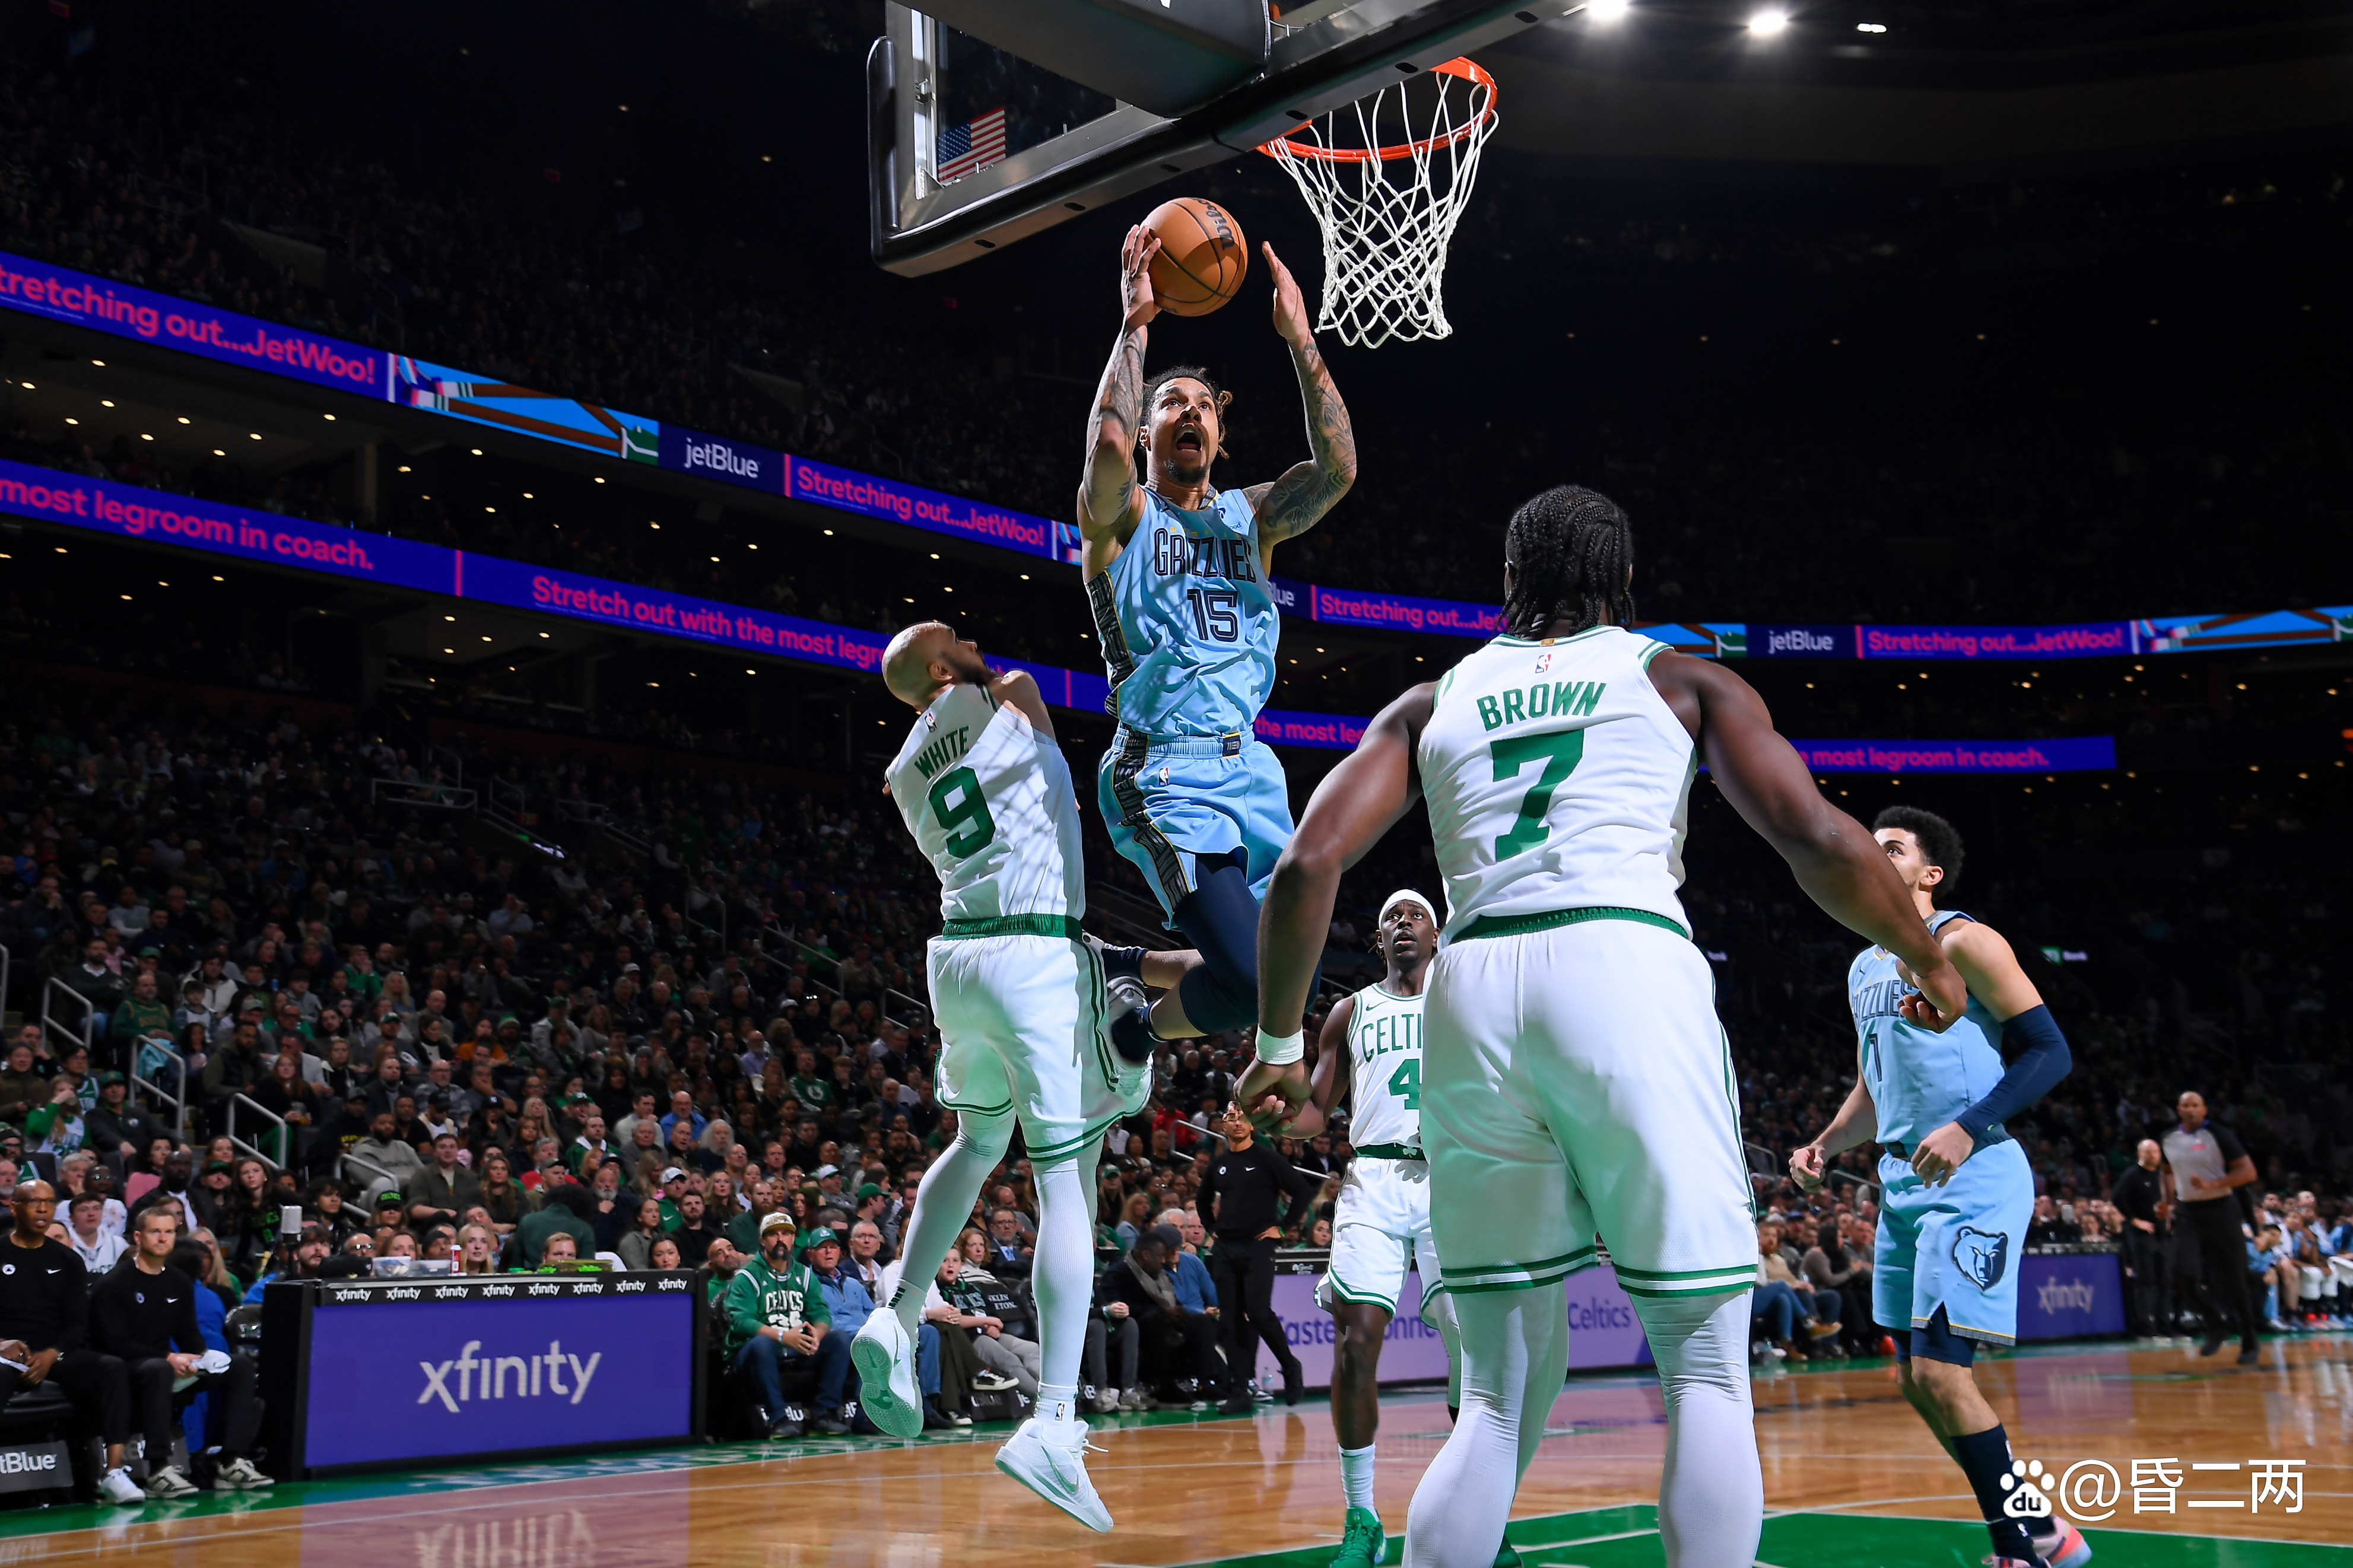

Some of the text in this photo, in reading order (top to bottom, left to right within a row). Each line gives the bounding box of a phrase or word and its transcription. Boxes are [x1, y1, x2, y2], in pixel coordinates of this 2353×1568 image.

[0, 265, 158, 337] tretching
[685, 438, 758, 478] jetBlue
[797, 466, 912, 520] Stretching
[0, 479, 373, 570] most legroom in coach.
[534, 576, 629, 617] Stretch
[634, 602, 675, 626] out
[680, 609, 731, 637] with
[736, 618, 774, 644] the
[779, 630, 834, 656] most
[1187, 589, 1238, 643] 15
[1321, 594, 1423, 628] Stretching
[1769, 631, 1833, 653] jetBlue
[1869, 631, 1977, 656] Stretching
[1477, 682, 1606, 731] BROWN
[914, 725, 970, 781] WHITE
[1285, 724, 1336, 742] most
[1813, 749, 1865, 766] most
[1869, 748, 1954, 771] legroom
[1957, 748, 1976, 766] in
[1979, 748, 2049, 766] coach.
[929, 765, 996, 860] 9
[1490, 728, 1584, 863] 7
[1361, 1013, 1422, 1063] CELTI
[1388, 1058, 1422, 1110] 4
[335, 1278, 687, 1302] xfinity xfinity xfinity xfinity xfinity xfinity xfinity xfinity
[1567, 1296, 1631, 1330] Celtics
[2038, 1277, 2093, 1315] xfinity
[418, 1340, 602, 1413] xfinity
[0, 1451, 57, 1475] tBlue
